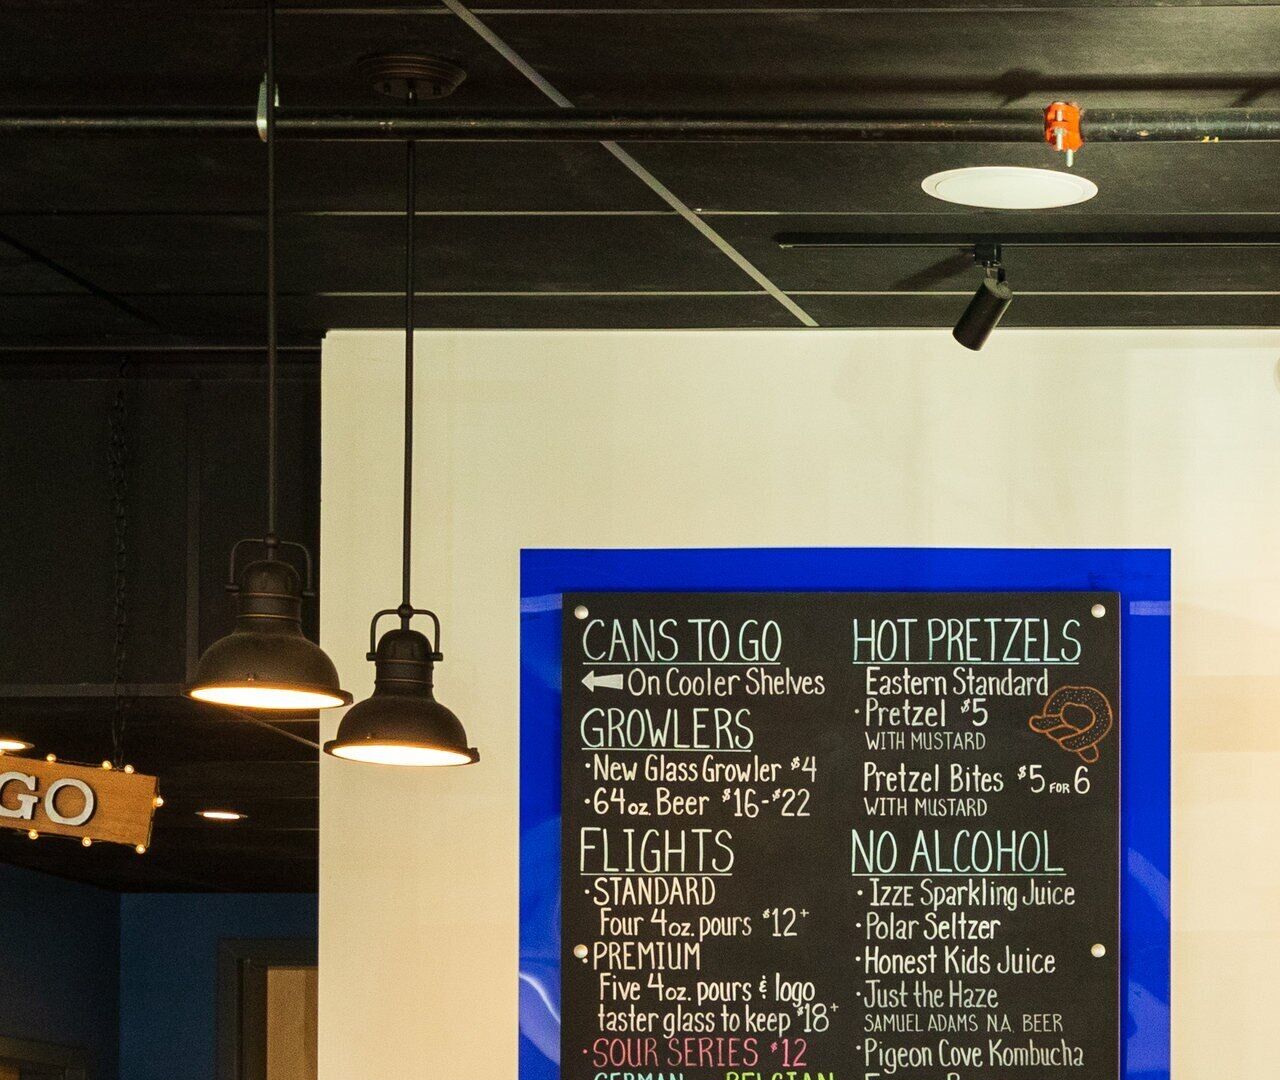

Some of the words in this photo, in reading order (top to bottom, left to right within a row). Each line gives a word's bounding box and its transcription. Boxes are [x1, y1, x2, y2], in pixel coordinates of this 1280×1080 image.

[583, 619, 678, 662] CANS
[688, 619, 730, 662] TO
[739, 619, 782, 662] GO
[854, 619, 917, 661] HOT
[928, 619, 1081, 661] PRETZELS
[628, 668, 660, 696] On
[666, 667, 740, 696] Cooler
[745, 667, 825, 696] Shelves
[866, 667, 947, 696] Eastern
[953, 667, 1048, 696] Standard
[580, 708, 754, 749] GROWLERS
[865, 732, 905, 751] WITH
[911, 732, 986, 750] MUSTARD
[0, 772, 94, 826] GO
[580, 827, 734, 872] FLIGHTS
[851, 829, 897, 873] NO
[911, 829, 1064, 873] ALCOHOL
[593, 876, 716, 906] STANDARD
[866, 912, 919, 940] Polar
[924, 912, 1001, 939] Seltzer
[594, 942, 701, 970] PREMIUM
[865, 945, 937, 974] Honest
[945, 945, 990, 974] Kids
[997, 945, 1055, 974] Juice
[593, 1038, 658, 1067] SOUR
[667, 1038, 759, 1067] SERIES
[865, 1038, 933, 1074] Pigeon
[938, 1039, 982, 1067] Cove
[989, 1039, 1084, 1067] Kombucha
